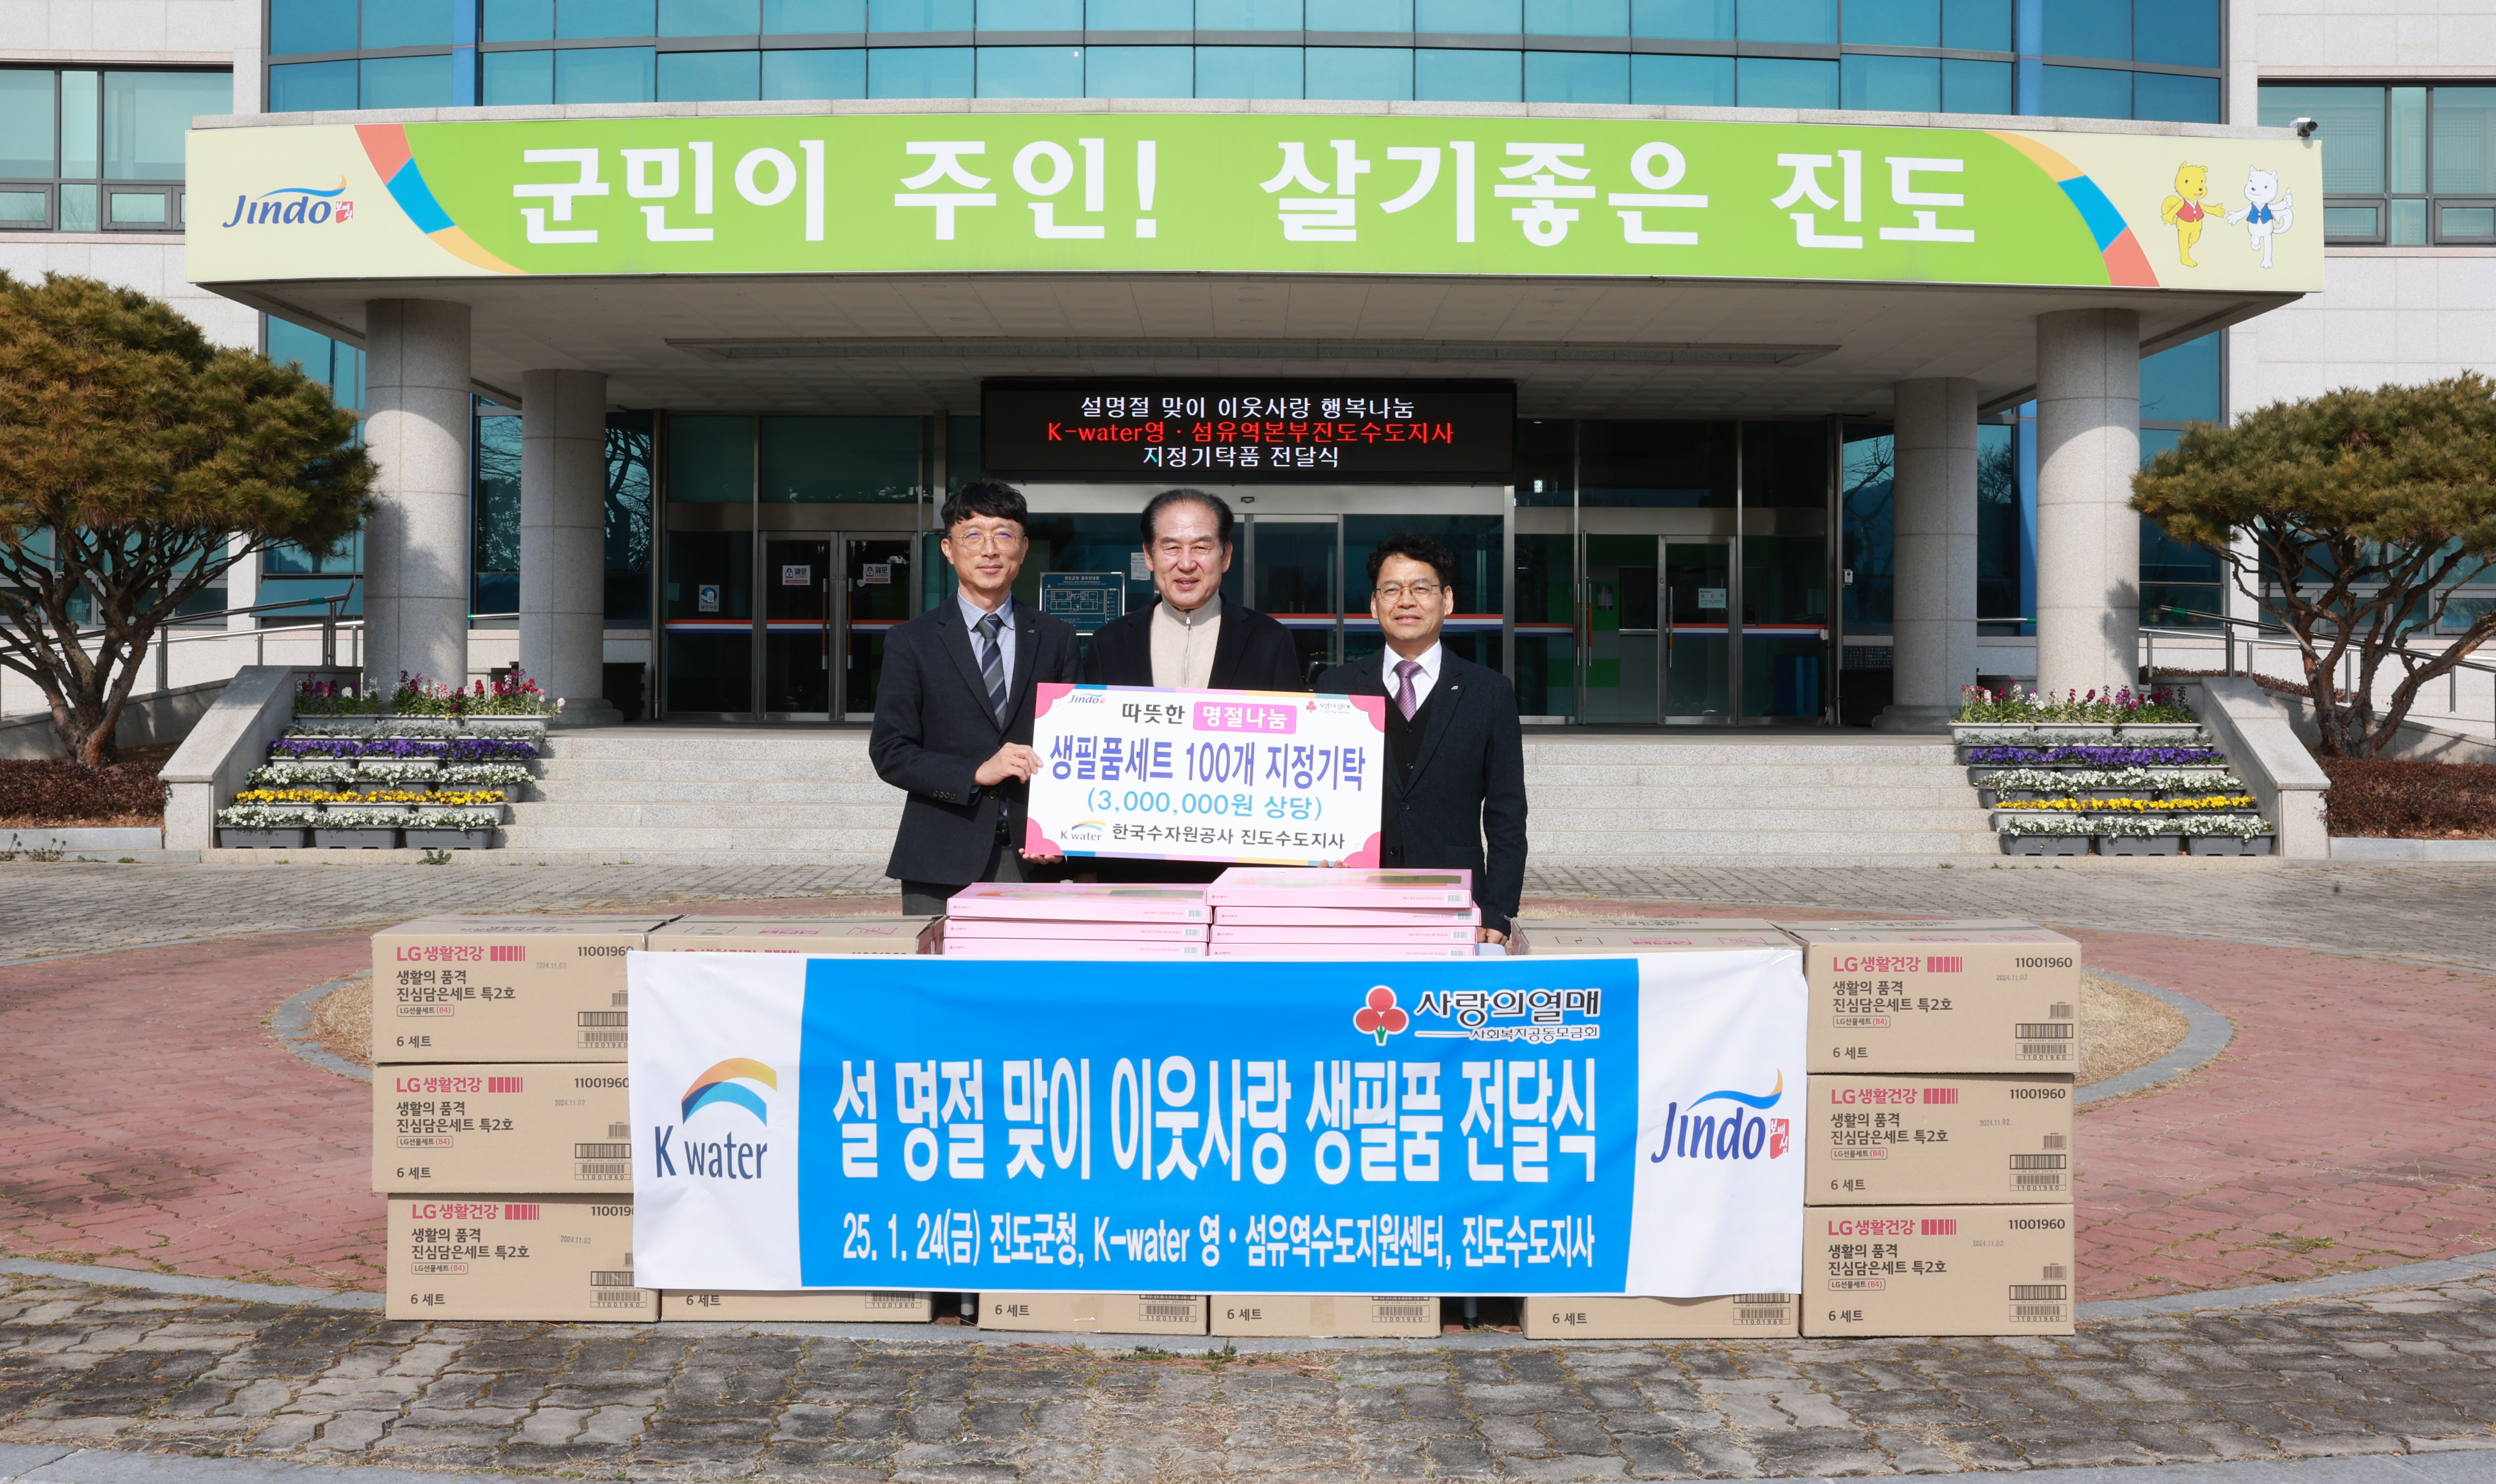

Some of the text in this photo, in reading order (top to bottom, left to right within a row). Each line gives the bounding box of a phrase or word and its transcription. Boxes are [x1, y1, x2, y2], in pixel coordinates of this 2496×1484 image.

[513, 138, 1975, 249] 군민이 주인! 살기좋은 진도
[223, 193, 333, 228] Jindo
[1081, 397, 1414, 418] 설명절 맞이 이웃사랑 행복나눔
[1144, 446, 1337, 467] 지정기탁품 전달식
[1068, 695, 1099, 703] Jindo
[1122, 704, 1288, 730] 따뜻한 명절나눔
[1050, 735, 1365, 791] 생필품세트 100개 지정기탁
[1088, 786, 1321, 821] (3,000,000원 상당)
[1113, 824, 1233, 844] 한국수자원공사
[1241, 830, 1345, 849] 진도수도지사
[2016, 957, 2072, 967] 11001960
[396, 970, 466, 985] 생활의 품격
[397, 987, 515, 1002] 진심담은세트 특2호
[1833, 981, 1902, 996] 생활의 품격
[1415, 989, 1600, 1029] 사랑의열매
[1833, 998, 1952, 1013] 진심담은세트 특2호
[397, 1036, 431, 1048] 6 세트
[1833, 1047, 1868, 1059] 6 세트
[2010, 1089, 2065, 1099] 11001960
[396, 1101, 464, 1116] 생활의 품격
[397, 1118, 513, 1133] 진심담은세트 특2호
[833, 1056, 1595, 1185] 설 명절 맞이 이웃사랑 생필품 전달식
[1831, 1113, 1899, 1128] 생활의 품격
[1651, 1101, 1765, 1164] Jindo
[1831, 1130, 1948, 1145] 진심담은세트 특2호
[655, 1125, 767, 1179] K water
[397, 1167, 431, 1180] 6 세트
[1831, 1179, 1865, 1192] 6 세트
[591, 1206, 634, 1216] 110019
[2009, 1219, 2065, 1229] 11001960
[412, 1228, 480, 1243] 생활의 품격
[844, 1212, 877, 1261] 25.
[889, 1214, 906, 1261] 1.
[917, 1209, 980, 1266] 24(금)
[990, 1212, 1083, 1268] 진도군청,
[1095, 1217, 1190, 1262] K-water
[1462, 1215, 1595, 1268] 진도수도지사
[412, 1245, 529, 1260] 진심담은세트 특2호
[1828, 1244, 1897, 1259] 생활의 품격
[1829, 1261, 1946, 1276] 진심담은세트 특2호
[411, 1294, 445, 1306] 6 세트
[697, 1294, 721, 1307] 세트
[1007, 1305, 1029, 1317] 세트
[1239, 1309, 1262, 1321] 세트
[1829, 1310, 1863, 1323] 6 세트
[1564, 1313, 1587, 1325] 세트
